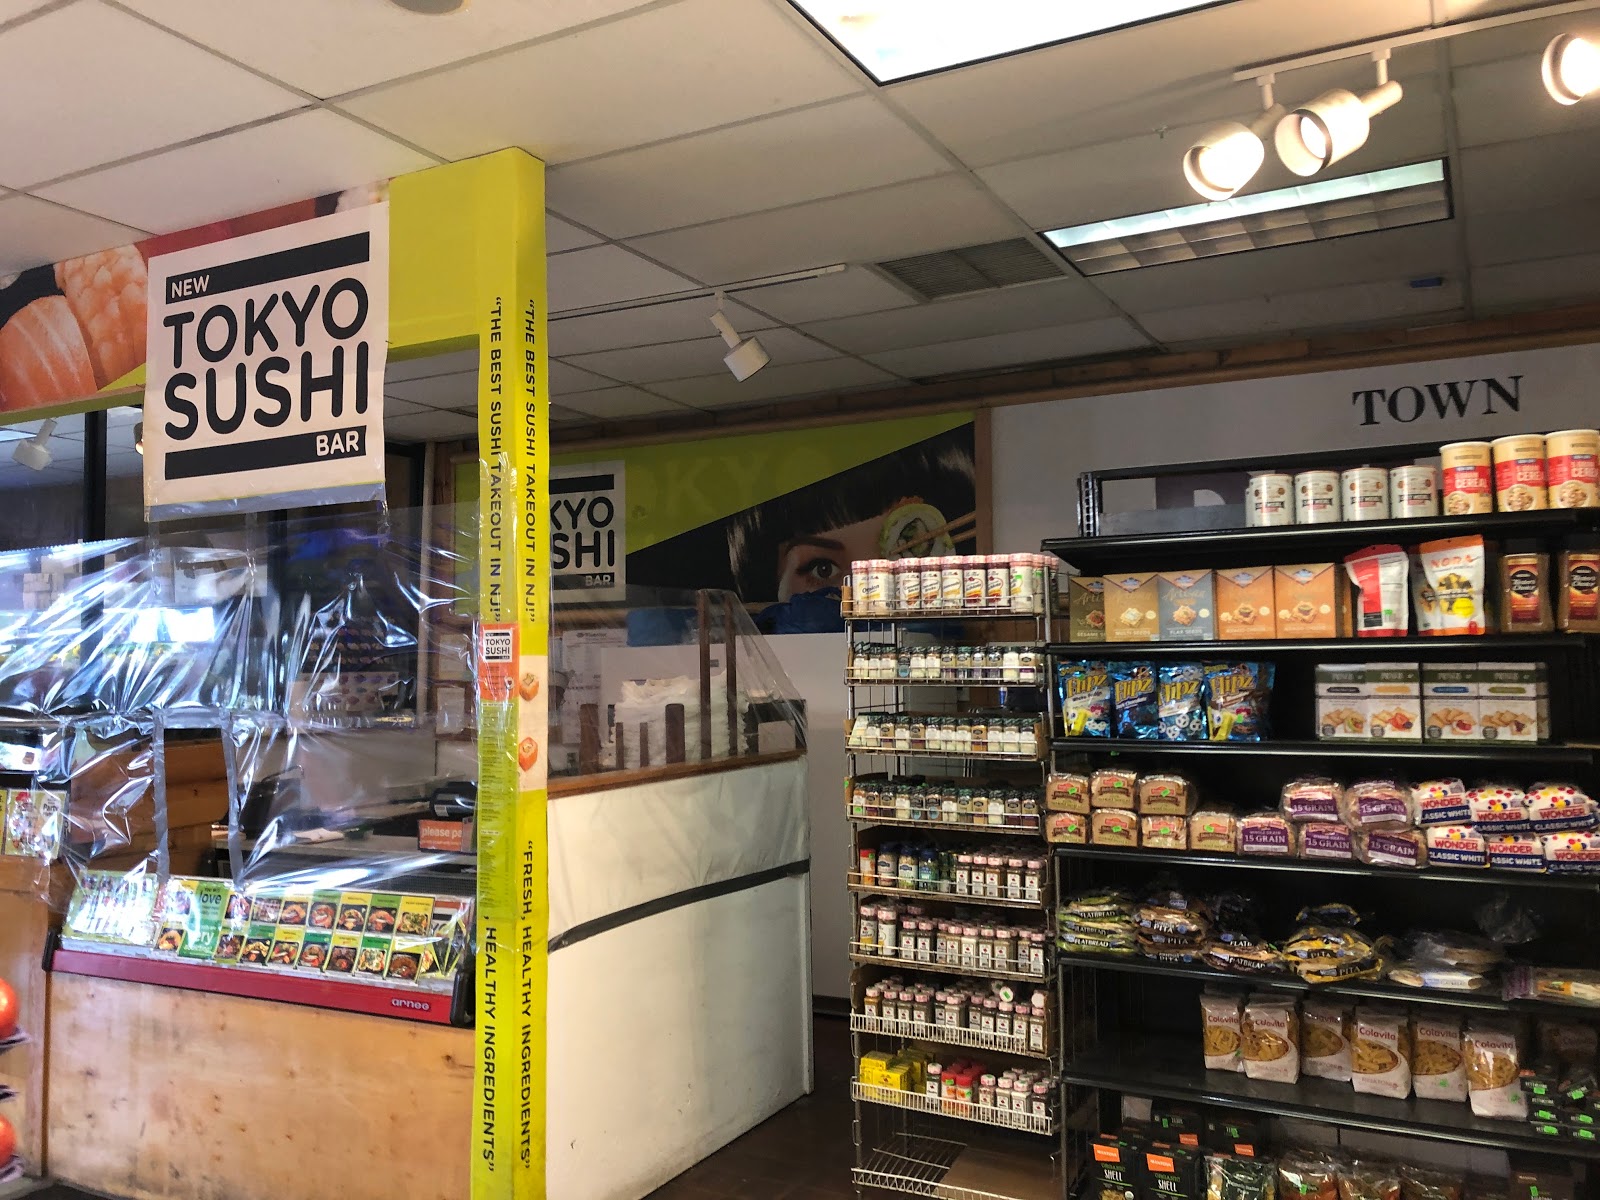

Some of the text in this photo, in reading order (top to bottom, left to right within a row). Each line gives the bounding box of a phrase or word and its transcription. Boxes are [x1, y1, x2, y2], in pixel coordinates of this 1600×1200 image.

[171, 274, 210, 299] NEW
[163, 277, 369, 369] TOKYO
[490, 348, 502, 395] BEST
[525, 349, 536, 398] BEST
[164, 341, 369, 441] SUSHI
[1352, 375, 1524, 426] TOWN
[490, 401, 502, 456] SUSHI
[525, 401, 536, 457] SUSHI
[316, 431, 359, 456] BAR
[490, 462, 502, 551] TAKEOUT
[525, 463, 536, 552] TAKEOUT
[549, 496, 614, 530] KYO
[552, 530, 615, 570] SHI
[490, 558, 502, 577] IN
[525, 558, 536, 577] IN
[585, 574, 611, 587] BAR
[485, 638, 511, 646] TOKYO
[485, 646, 511, 655] SUSHI
[1303, 804, 1335, 812] GRAIN
[1421, 797, 1463, 808] WONDER
[1424, 811, 1447, 819] ASSIC
[1477, 811, 1522, 820] WONDER
[1540, 807, 1585, 819] WONDER
[421, 826, 450, 839] please
[1244, 834, 1285, 843] 15 GRAIN
[1307, 838, 1350, 849] 15 GRAIN
[1370, 841, 1415, 856] 15 GRAIN
[1434, 839, 1479, 851] WONDER
[1488, 844, 1533, 854] WONDER
[1491, 856, 1514, 865] ASSIC
[1080, 911, 1116, 919] FLATBREAD
[1153, 923, 1174, 934] PITA
[1074, 938, 1109, 948] FLATBREAD
[1167, 937, 1189, 945] PITA
[484, 927, 497, 1020] HEALTHY
[520, 926, 532, 1017] HEALTHY
[1339, 966, 1361, 976] PITA
[1207, 1015, 1239, 1023] Colavita
[1255, 1018, 1285, 1028] Colavita
[1359, 1026, 1396, 1041] Colavita
[1419, 1027, 1458, 1039] Colavita
[1474, 1039, 1514, 1049] Colavita
[1104, 1169, 1123, 1182] SHELL
[1157, 1179, 1178, 1193] SHELL
